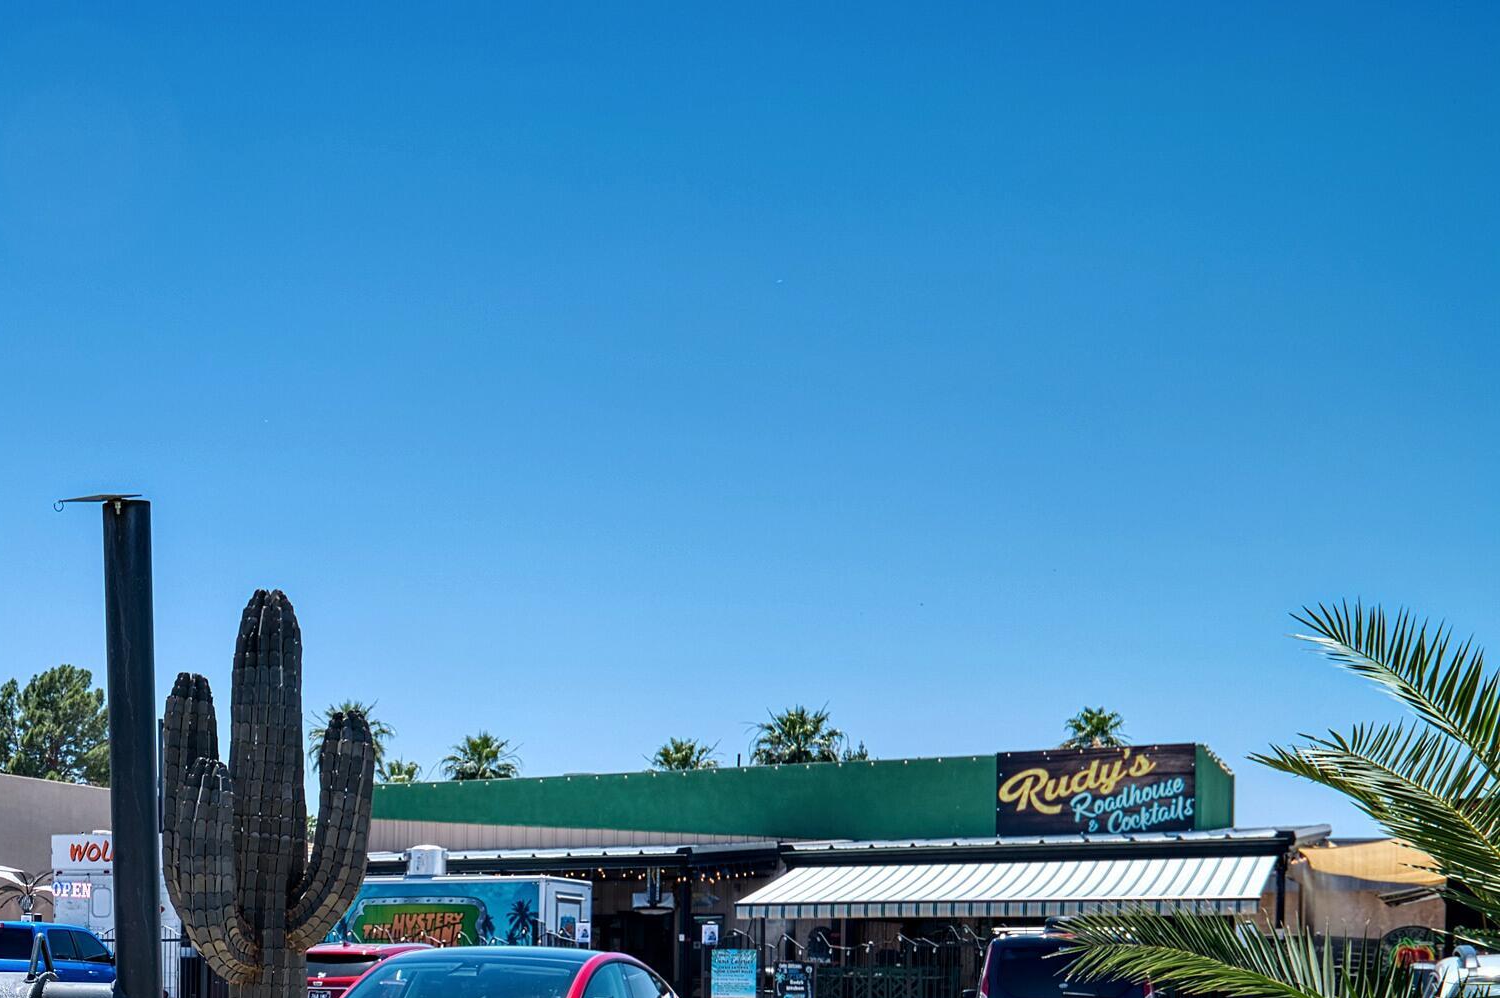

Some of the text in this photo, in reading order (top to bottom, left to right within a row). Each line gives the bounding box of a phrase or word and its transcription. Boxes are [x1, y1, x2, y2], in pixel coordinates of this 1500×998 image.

[998, 748, 1157, 815] Rudy's
[1070, 777, 1185, 823] Roadhouse
[1088, 796, 1194, 835] & Cocktails
[52, 881, 92, 898] OPEN
[363, 912, 464, 940] THE MYSTERY
